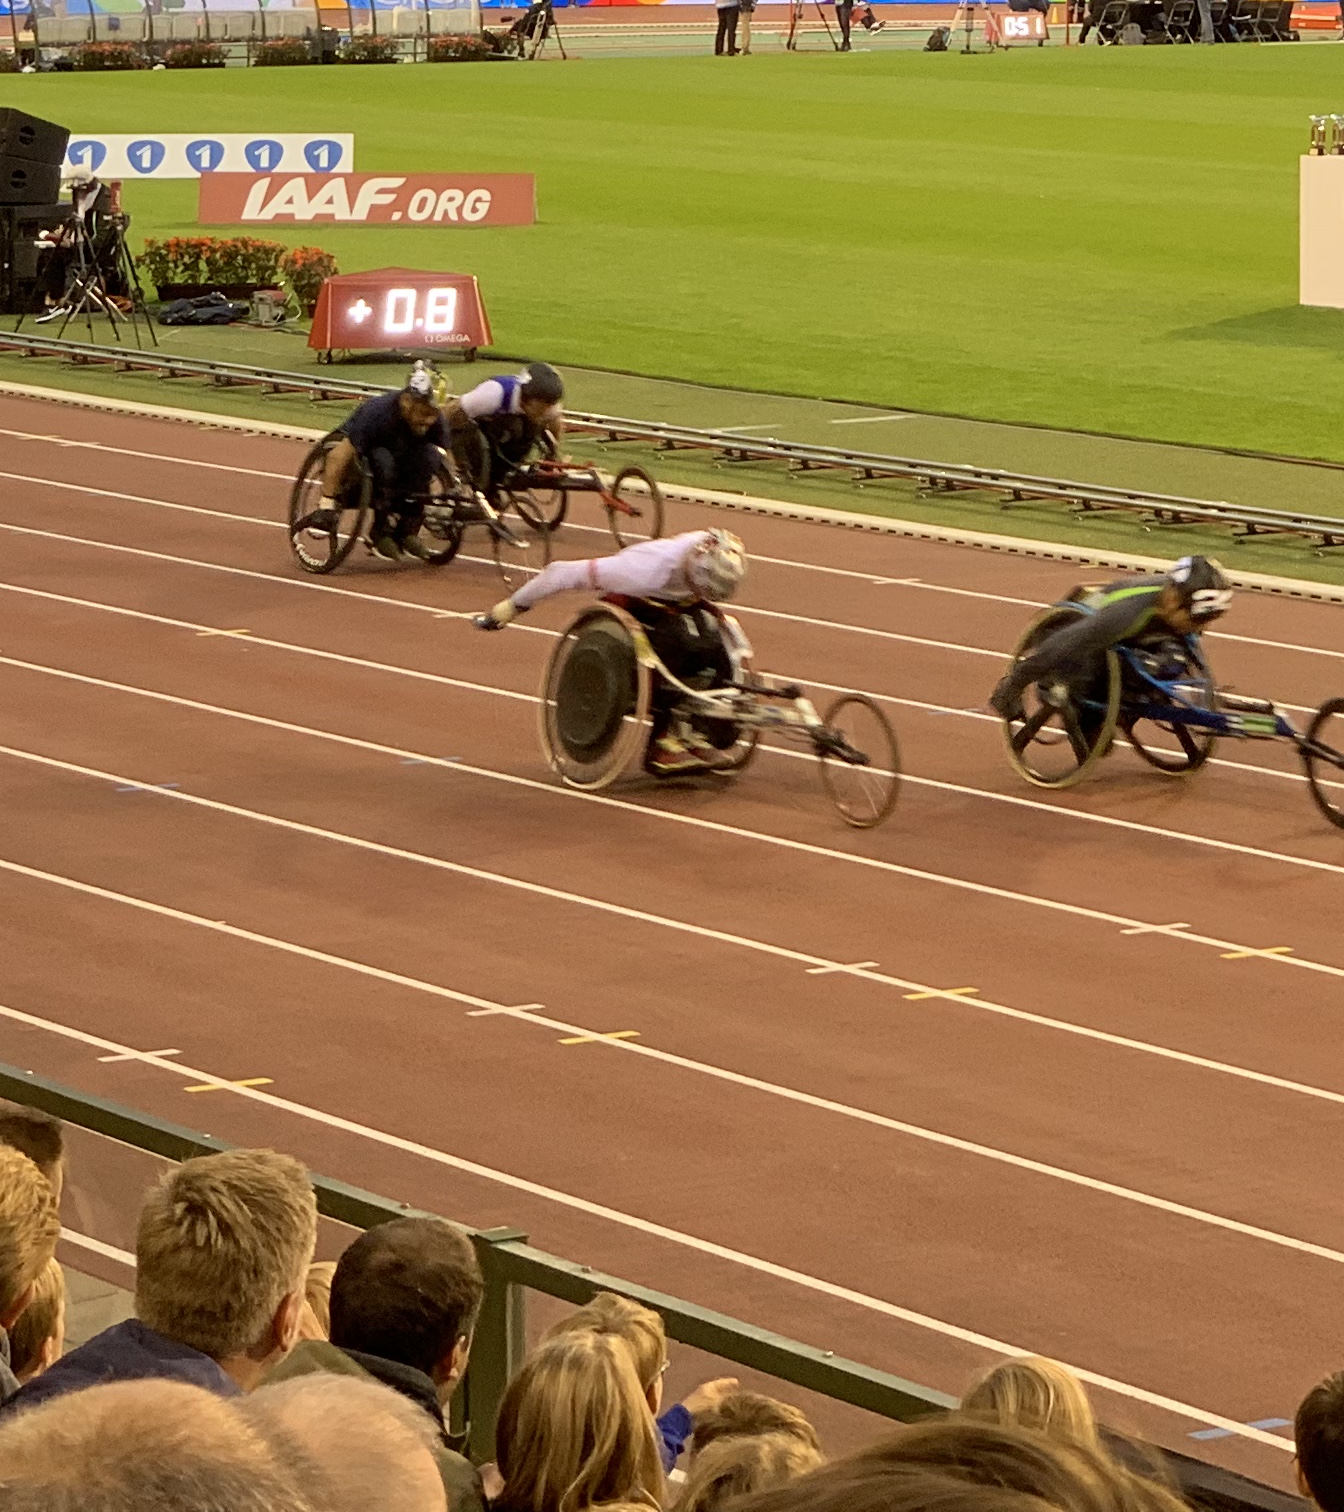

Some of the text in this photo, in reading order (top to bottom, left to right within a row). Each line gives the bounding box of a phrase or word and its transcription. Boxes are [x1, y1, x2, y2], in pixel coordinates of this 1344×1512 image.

[241, 176, 492, 221] IAAF.ORG
[384, 287, 457, 333] 0.8
[435, 333, 471, 343] OMEGA
